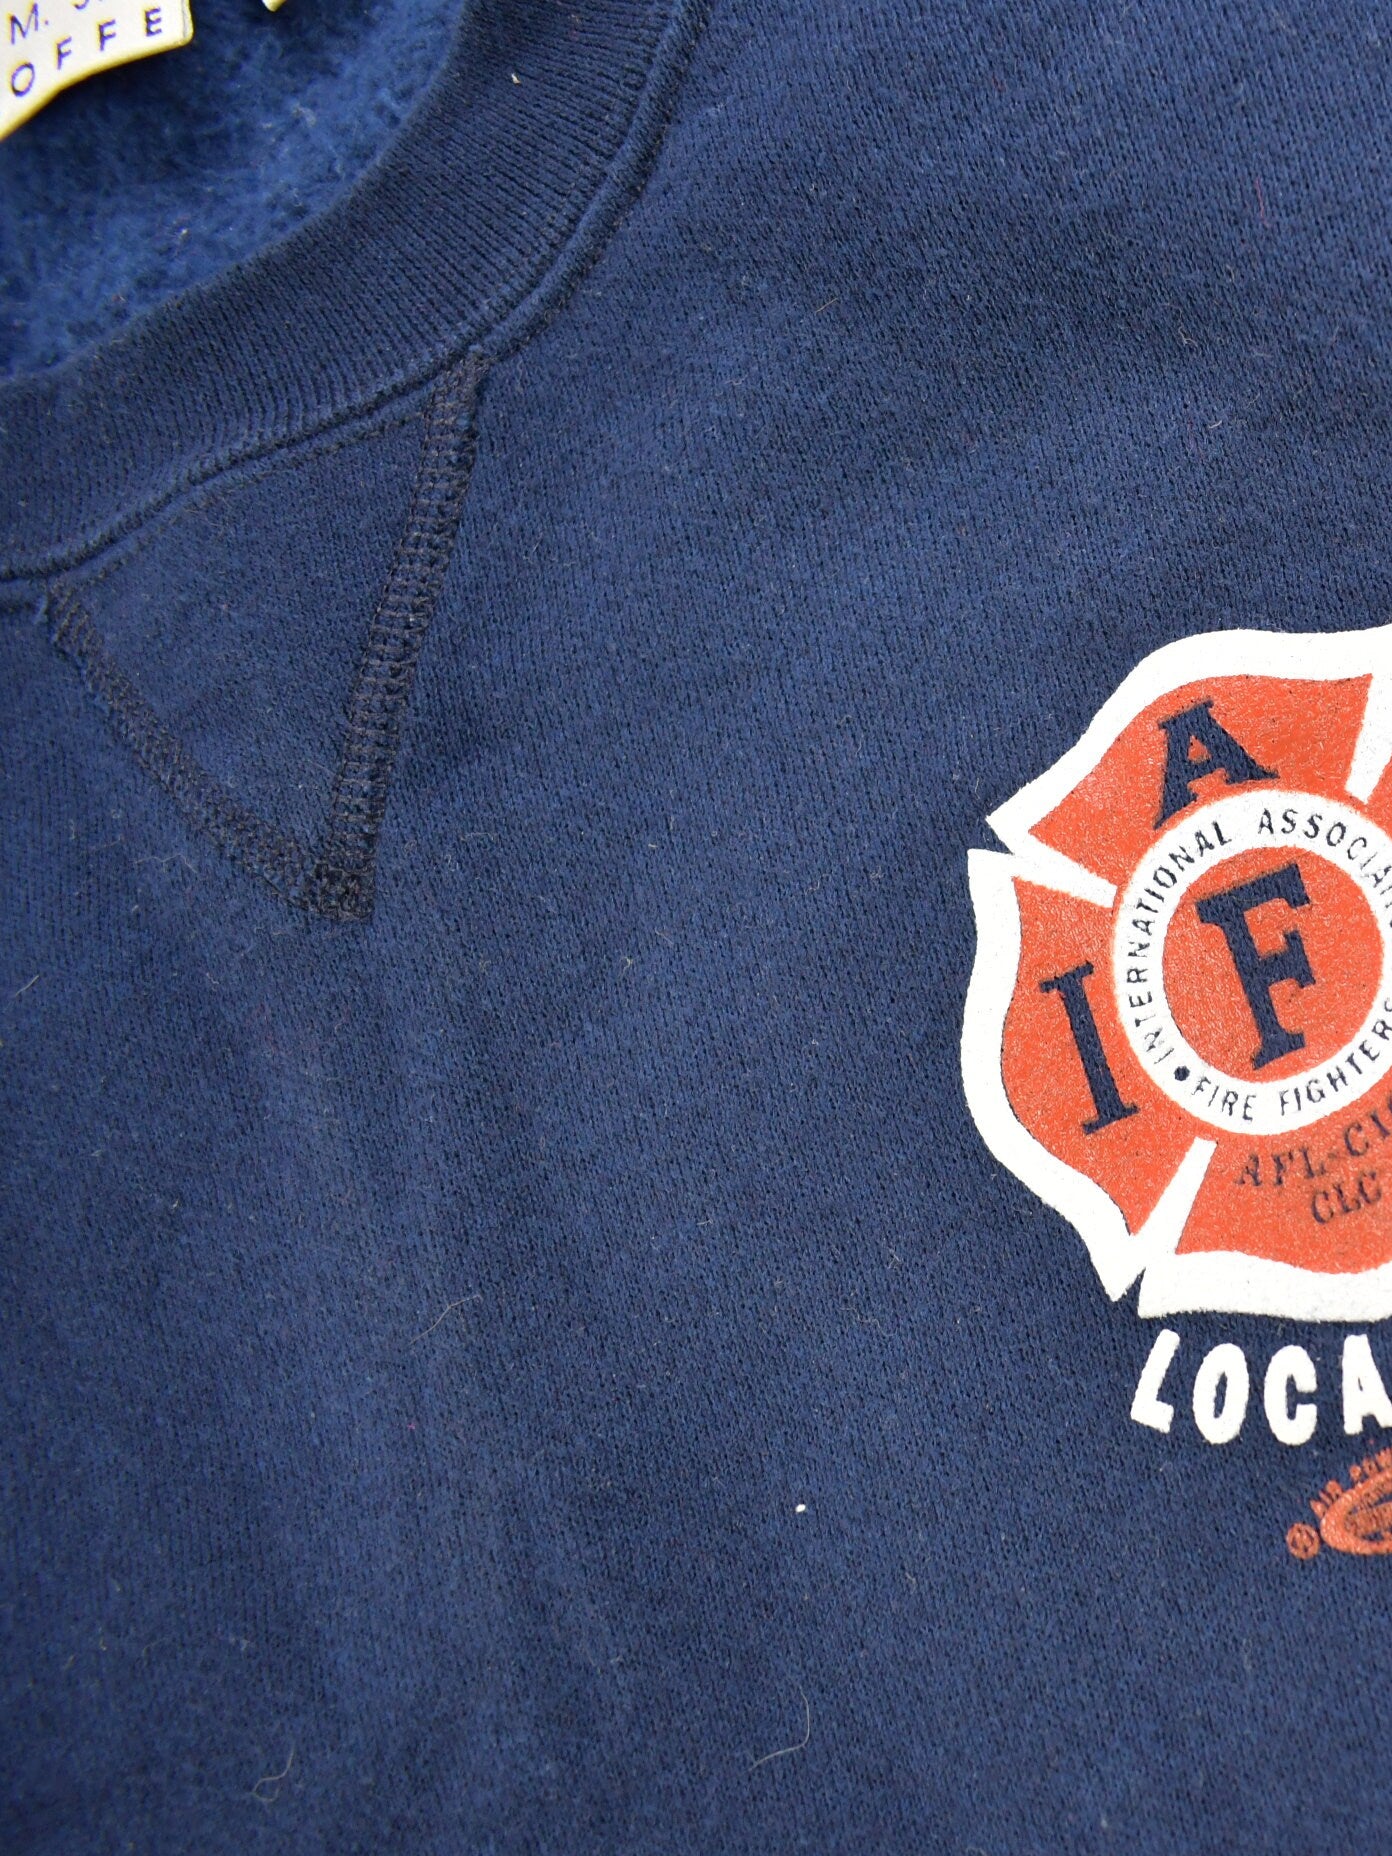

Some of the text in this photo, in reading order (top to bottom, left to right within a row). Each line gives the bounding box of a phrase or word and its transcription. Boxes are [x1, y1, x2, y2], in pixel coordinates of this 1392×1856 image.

[1039, 961, 1139, 1136] I
[1152, 700, 1278, 829] A
[1127, 821, 1233, 1065] INTERNATIONAL
[1196, 862, 1317, 1071] F
[1191, 1075, 1257, 1121] FIRE
[1310, 1169, 1383, 1225] CLC
